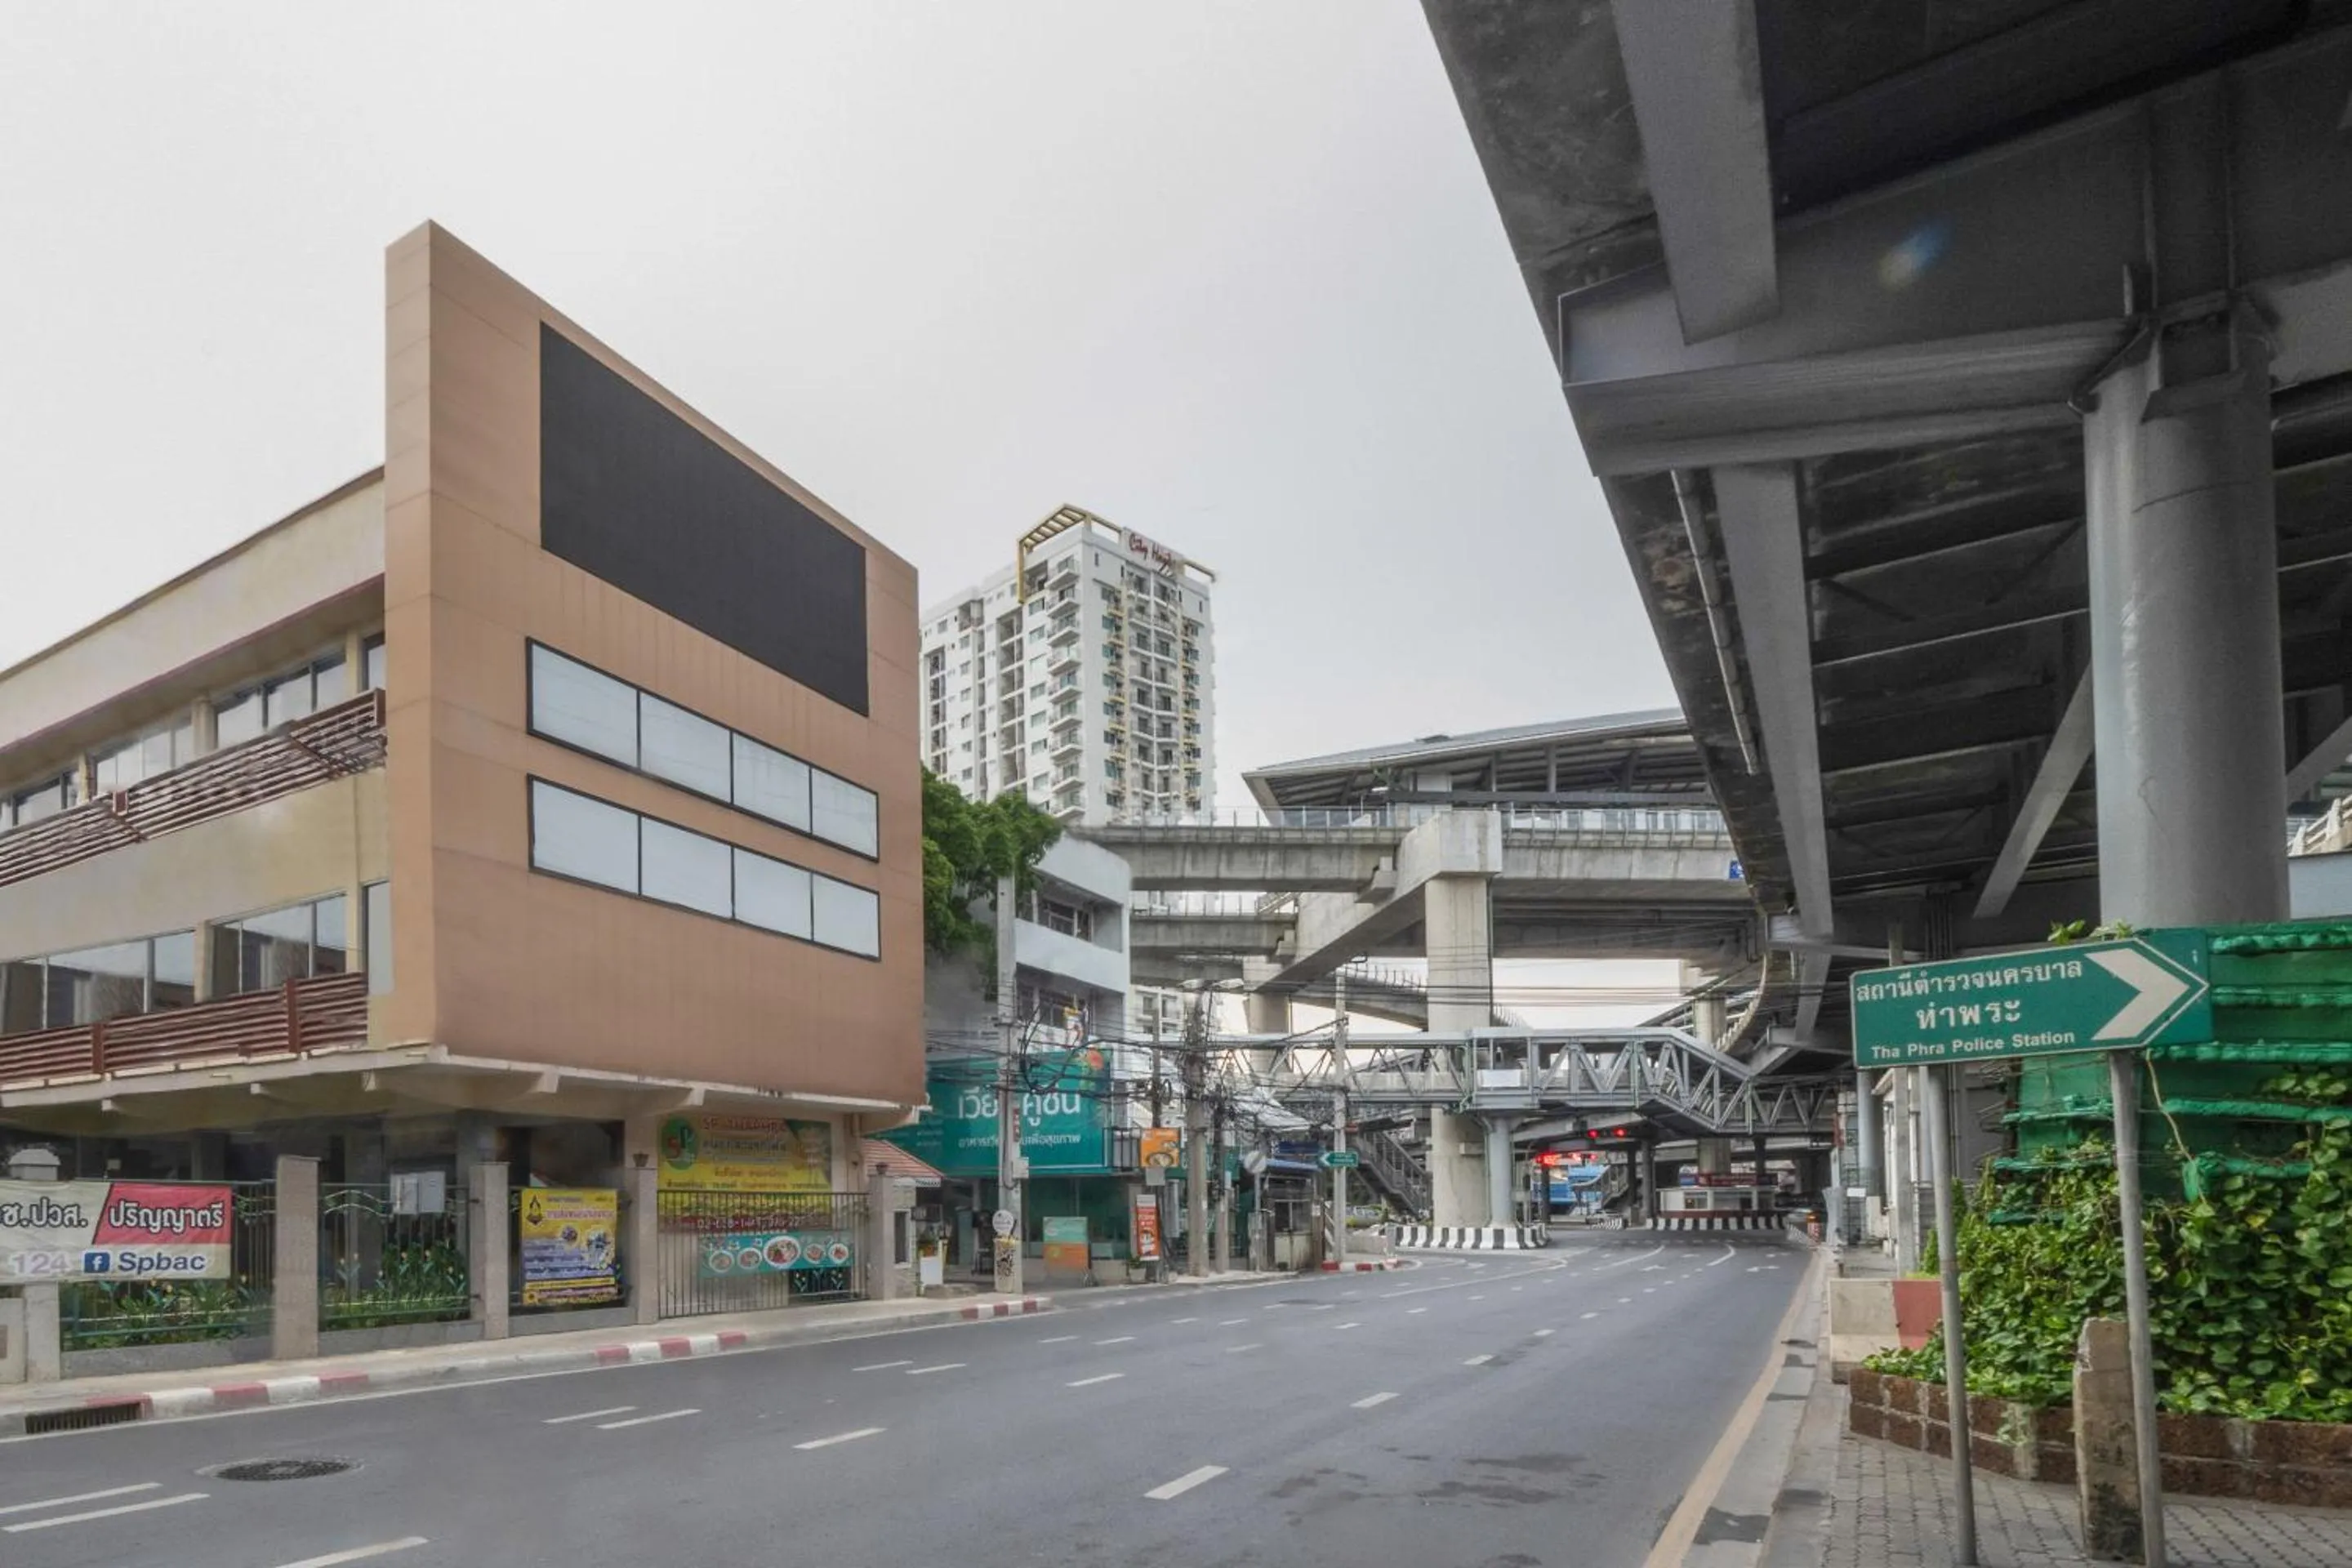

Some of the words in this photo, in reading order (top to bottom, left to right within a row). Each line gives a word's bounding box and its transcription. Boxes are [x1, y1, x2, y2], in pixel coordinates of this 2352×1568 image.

[1855, 960, 2082, 1002] สถานีตำรวจนครบาล
[1916, 1000, 2021, 1030] ท่าพระ
[1871, 1045, 1900, 1059] Tha
[1908, 1043, 1945, 1057] Phra
[1953, 1037, 2005, 1054] Police
[2011, 1031, 2075, 1048] Station
[109, 1200, 225, 1234] ปริญญาตรี
[11, 1253, 68, 1274] 124
[118, 1251, 206, 1275] Spbac
